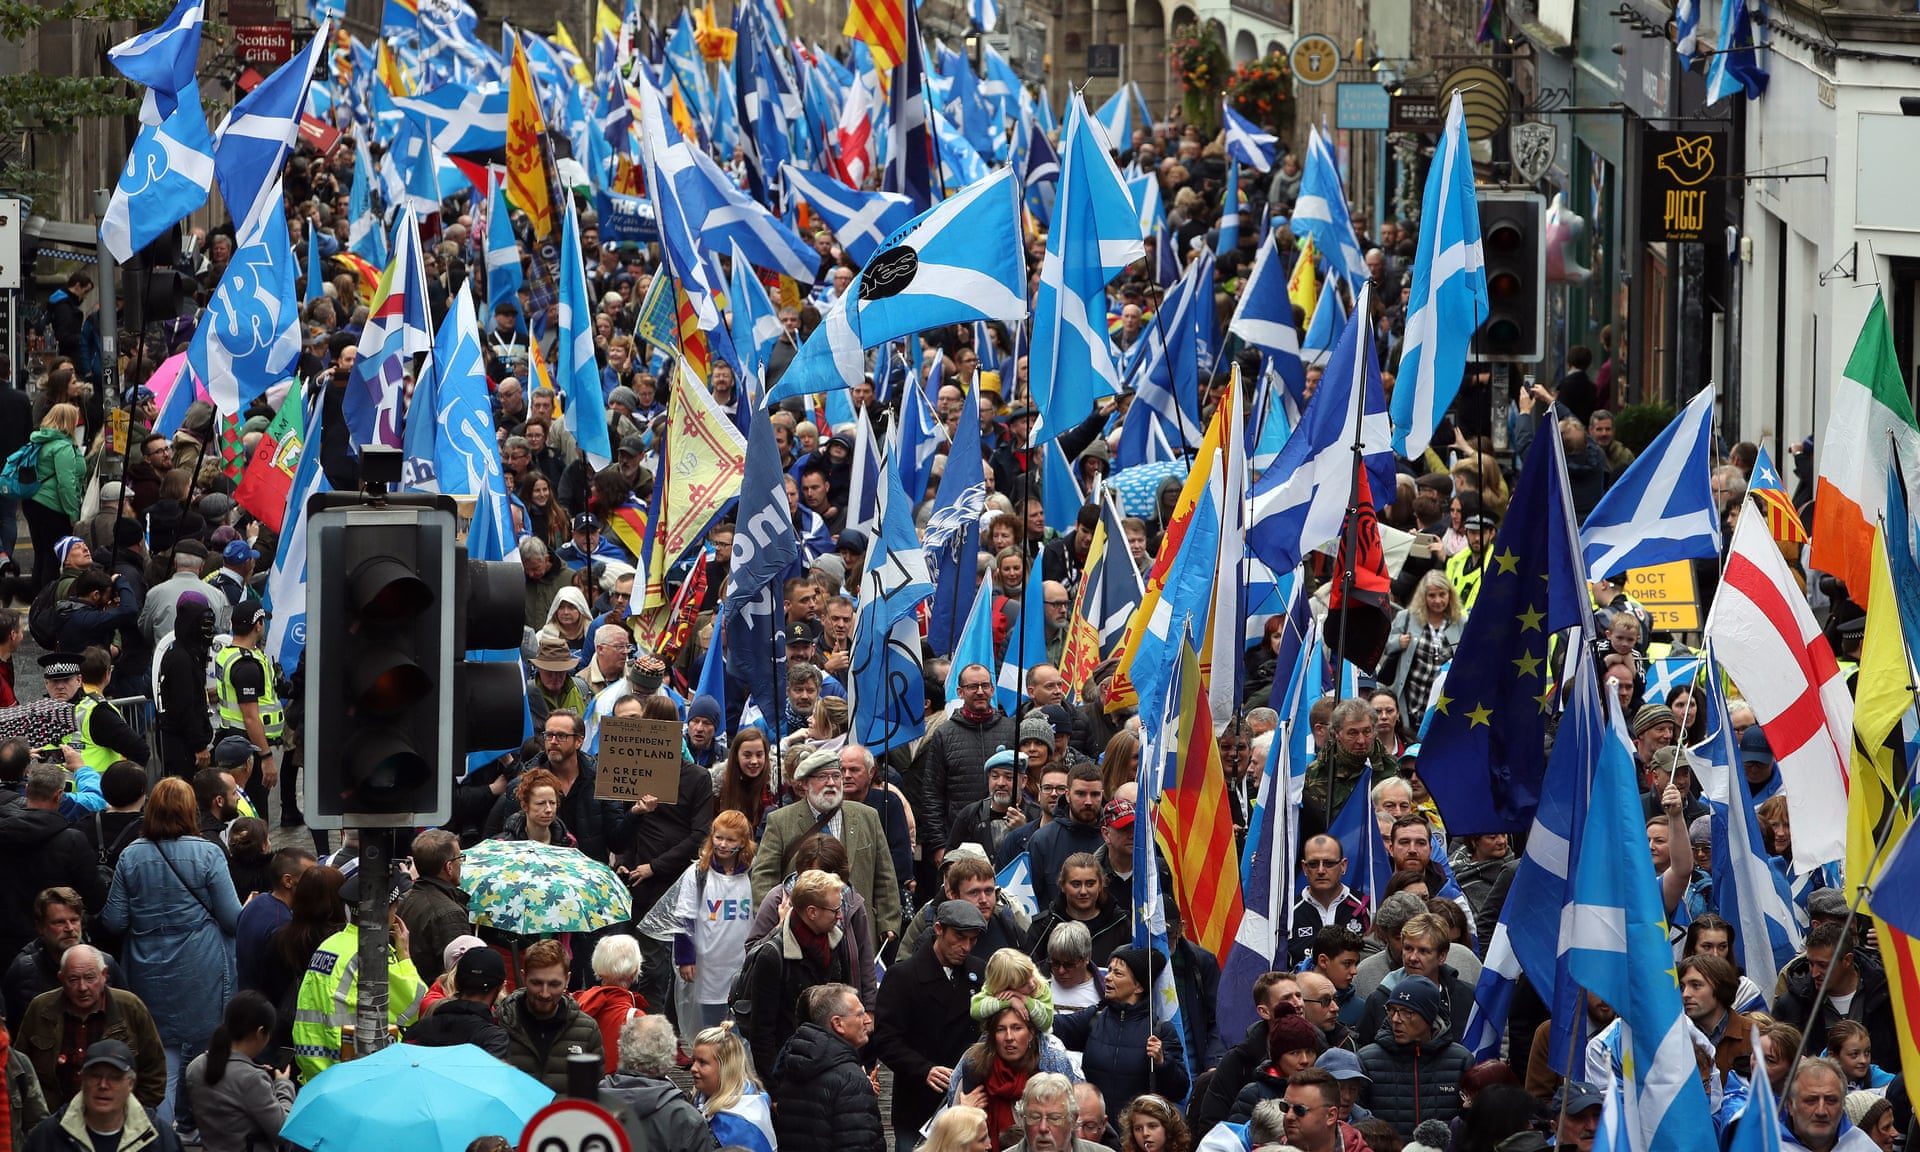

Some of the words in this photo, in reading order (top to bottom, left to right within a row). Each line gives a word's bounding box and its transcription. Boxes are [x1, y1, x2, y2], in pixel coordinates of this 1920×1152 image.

[236, 33, 286, 47] Scottish
[246, 48, 277, 61] Gifts
[611, 198, 637, 215] THE
[1663, 190, 1707, 230] PIGGS
[1635, 573, 1666, 584] OCT
[1651, 611, 1680, 623] ETS
[603, 734, 672, 747] INDEPENDENT
[609, 746, 675, 760] SCOTLAND
[602, 766, 609, 774] A
[613, 766, 653, 778] GREEN
[613, 776, 638, 786] NEW
[612, 786, 640, 796] DEAL
[706, 898, 751, 921] YES
